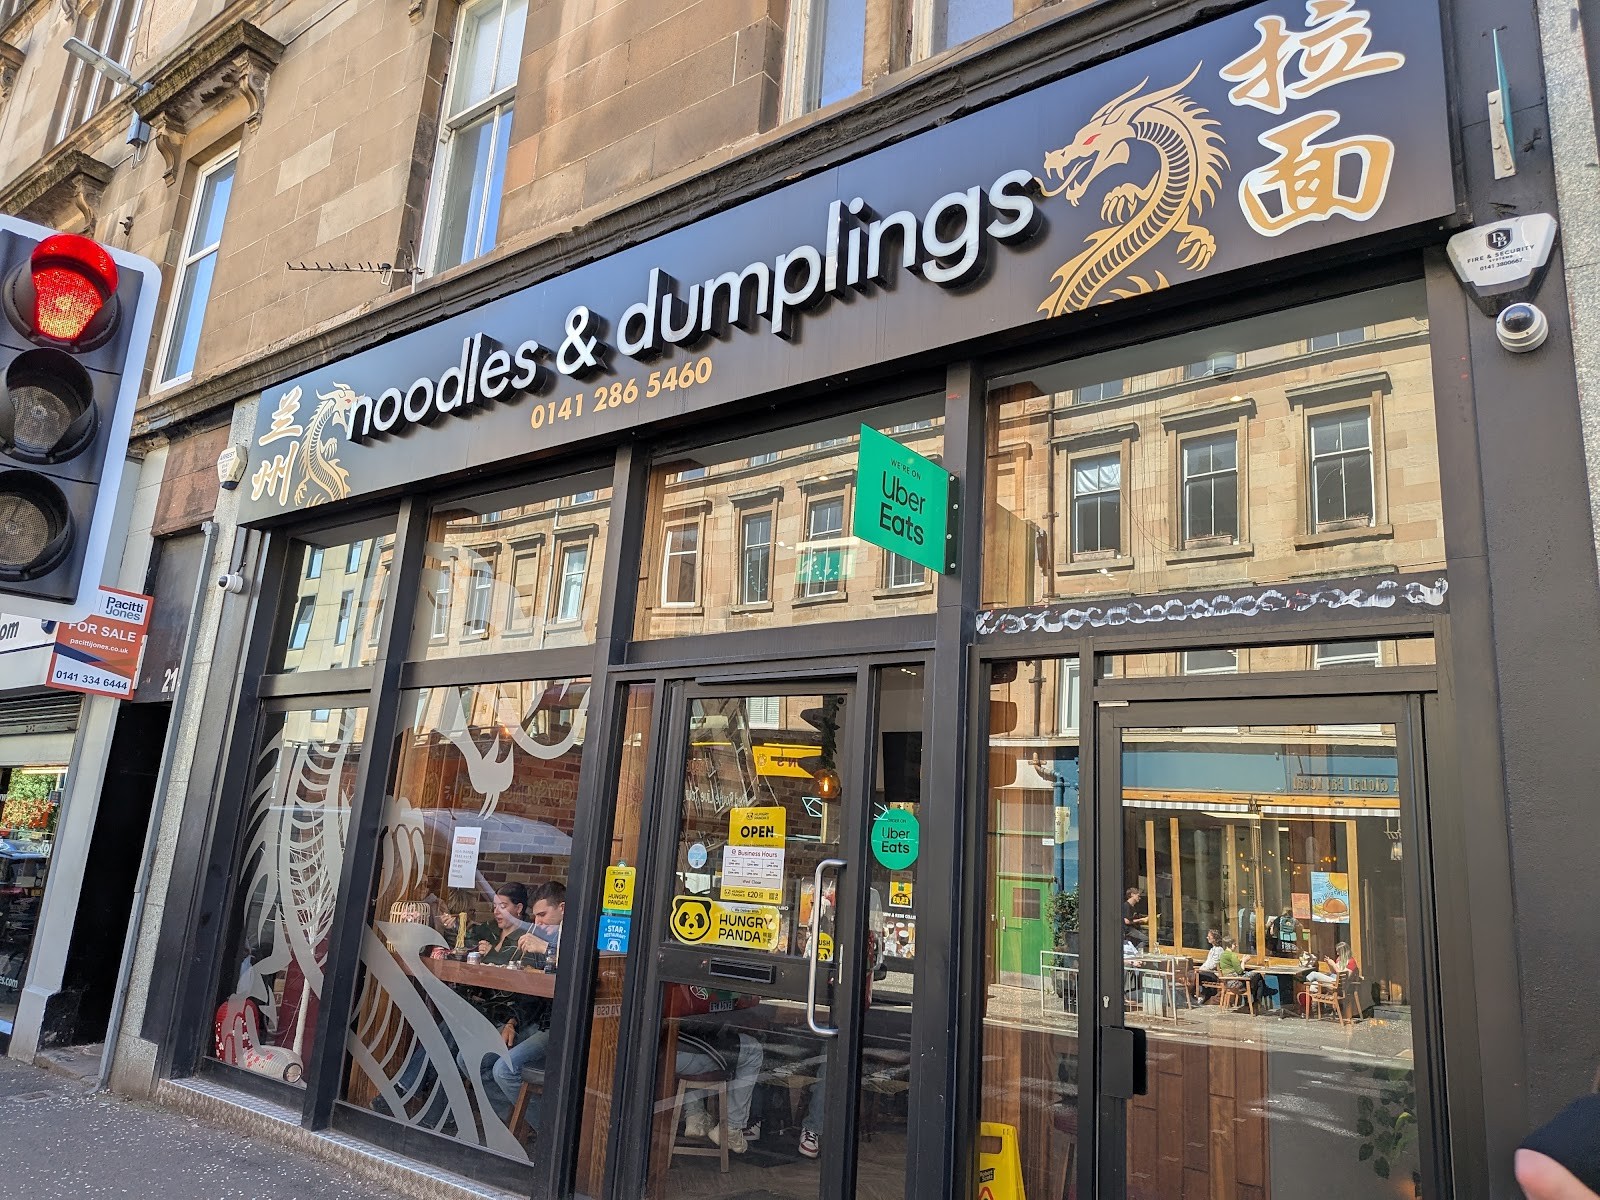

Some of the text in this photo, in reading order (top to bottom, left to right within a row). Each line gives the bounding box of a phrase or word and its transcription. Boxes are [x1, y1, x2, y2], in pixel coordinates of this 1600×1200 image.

[1467, 255, 1484, 264] FIRE
[1495, 244, 1535, 258] SECURITY
[346, 169, 1034, 441] noodles & dumplings
[530, 356, 713, 430] 0141 286 5460
[251, 385, 303, 506] 兰州
[890, 458, 921, 480] WE'RE ON
[882, 470, 926, 515] Uber
[880, 502, 924, 546] Eats
[105, 605, 141, 621] Jones
[106, 596, 144, 613] Pacitti
[100, 626, 137, 642] SALE
[69, 638, 129, 654] pacittijones.co.uk
[56, 670, 128, 690] 0141 334 6444
[161, 667, 179, 692] 21
[741, 825, 774, 838] OPEN
[881, 826, 910, 840] Uber
[738, 849, 761, 857] Business
[881, 840, 910, 854] Eats
[607, 925, 624, 934] STAR
[719, 913, 773, 930] HUNGRY
[718, 927, 761, 943] PANDA
[818, 939, 831, 947] USH
